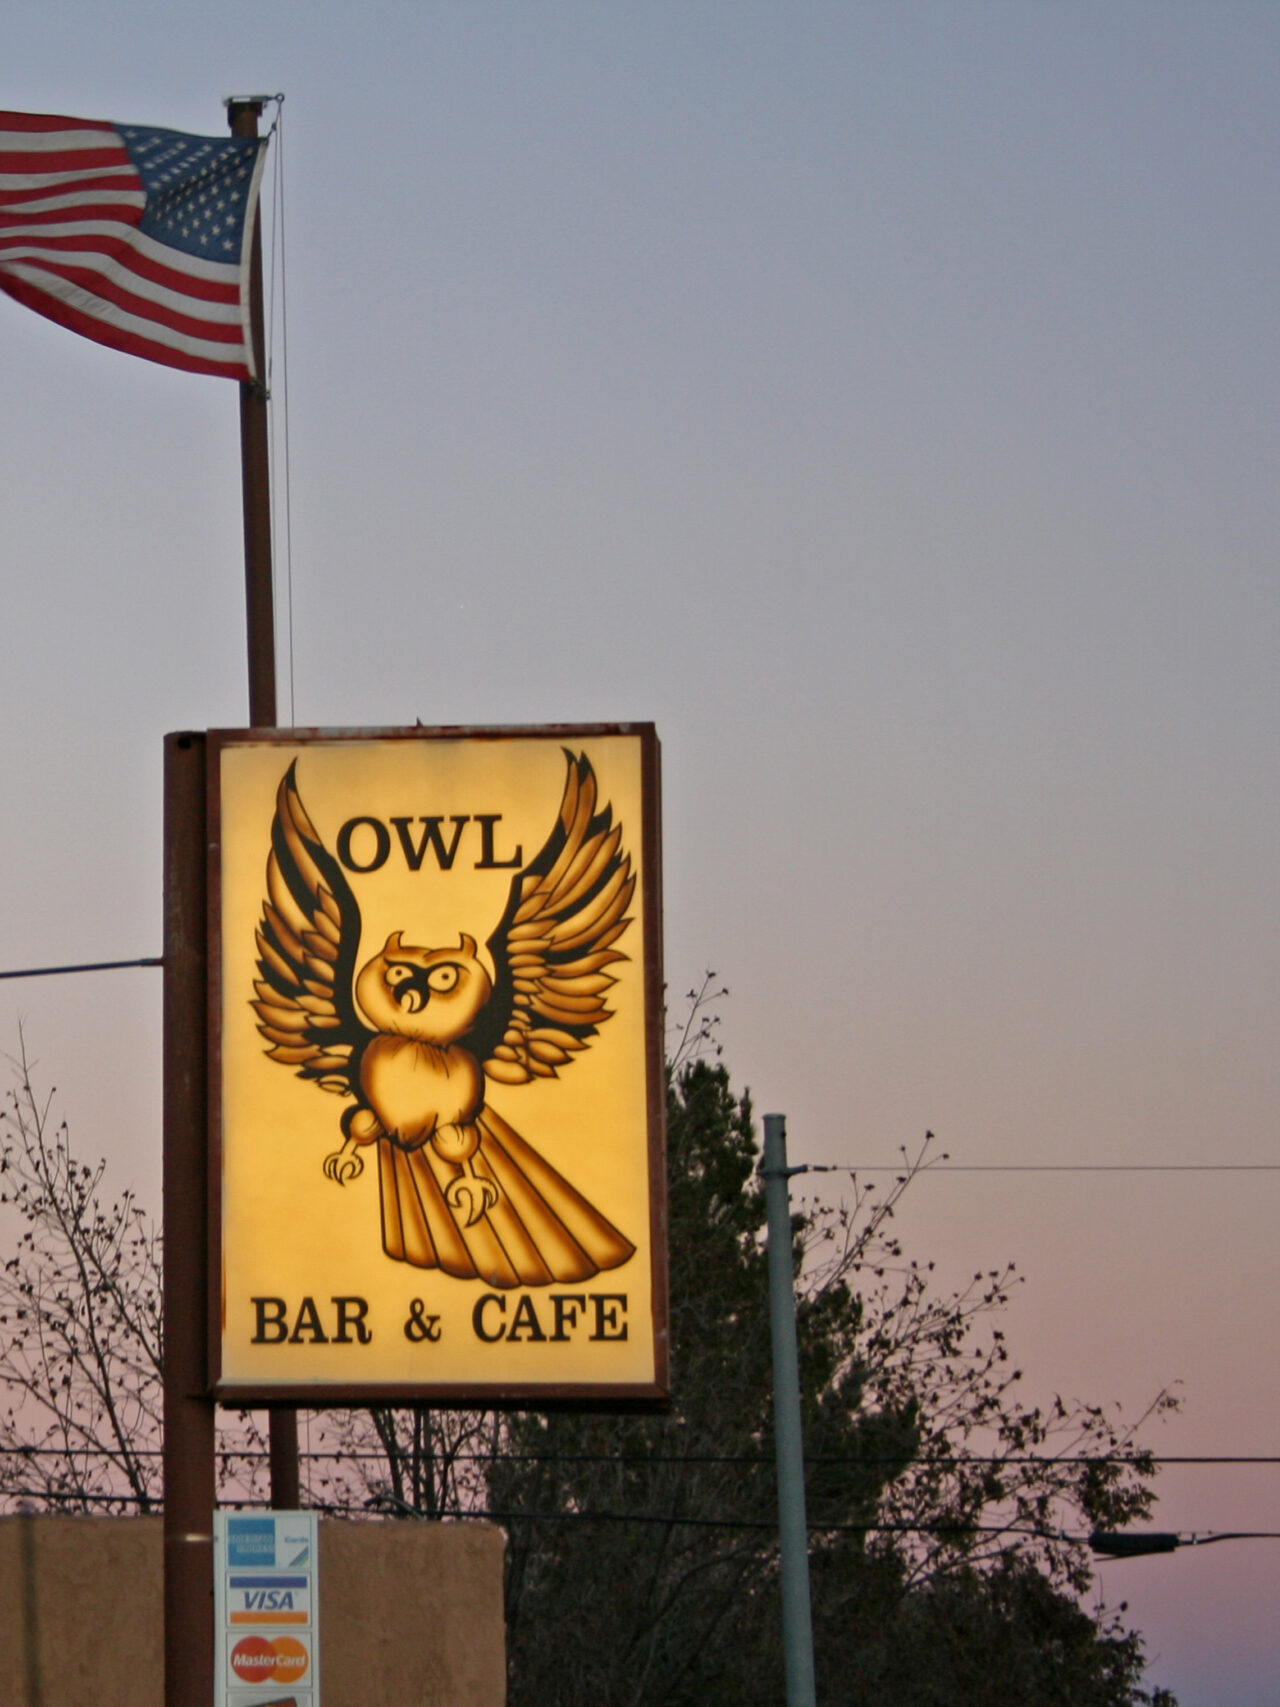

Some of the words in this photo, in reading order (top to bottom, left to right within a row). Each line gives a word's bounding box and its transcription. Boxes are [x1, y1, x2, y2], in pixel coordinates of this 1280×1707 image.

[336, 813, 522, 873] OWL
[250, 1296, 372, 1345] BAR
[403, 1297, 441, 1343] &
[471, 1292, 628, 1343] CAFE
[243, 1591, 294, 1610] VISA
[233, 1653, 307, 1668] MasterCard
